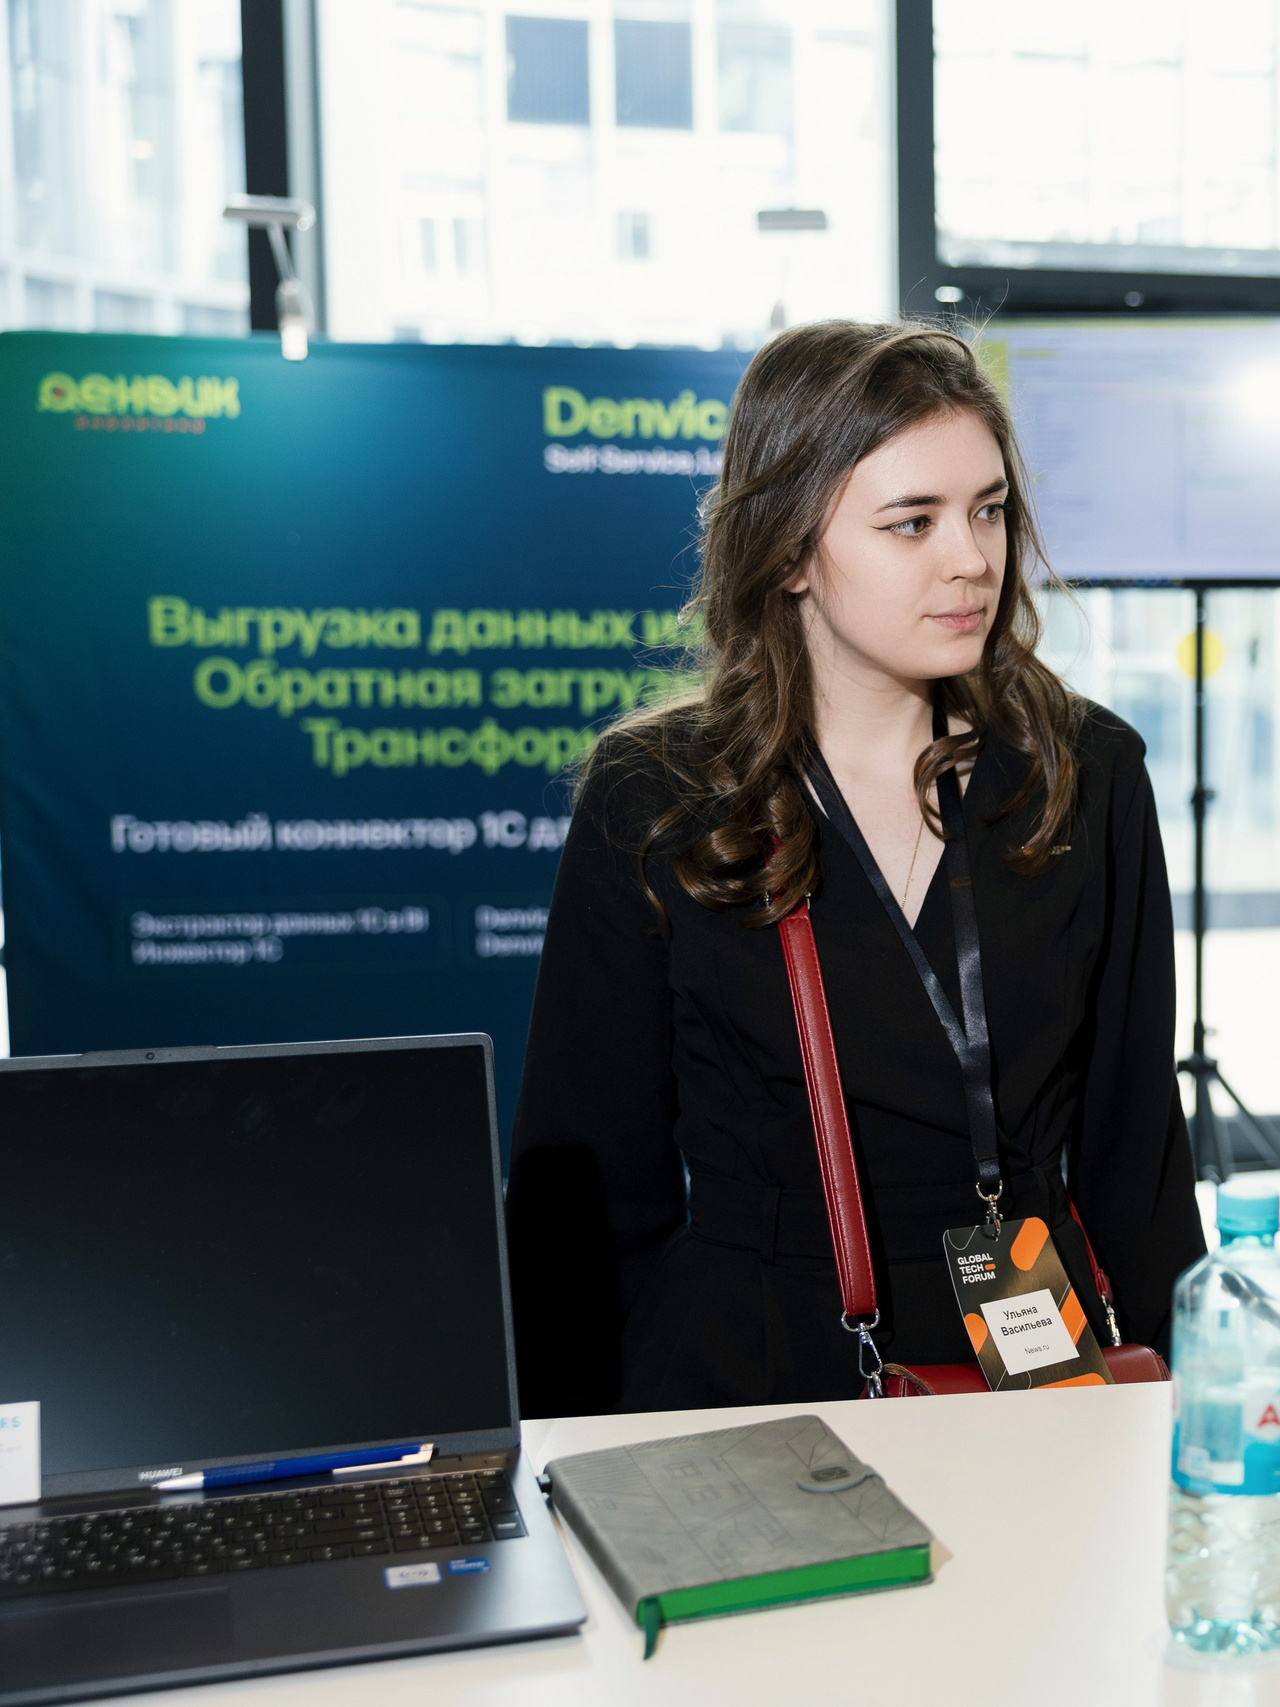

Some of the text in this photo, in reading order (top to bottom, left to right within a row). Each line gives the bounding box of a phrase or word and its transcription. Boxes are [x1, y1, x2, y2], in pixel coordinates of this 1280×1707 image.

[148, 596, 420, 655] Выгрузка
[428, 607, 636, 655] данных
[194, 656, 481, 717] Обратная
[111, 811, 272, 853] Готовый
[276, 817, 477, 853] коннектор
[957, 1253, 993, 1265] GLOBAL
[959, 1264, 984, 1275] TECH
[962, 1271, 996, 1284] FORUM
[1003, 1306, 1038, 1320] Ульяна
[1001, 1317, 1053, 1336] Васильева
[1024, 1344, 1050, 1355] News.ru
[138, 1467, 183, 1480] HUAWEI
